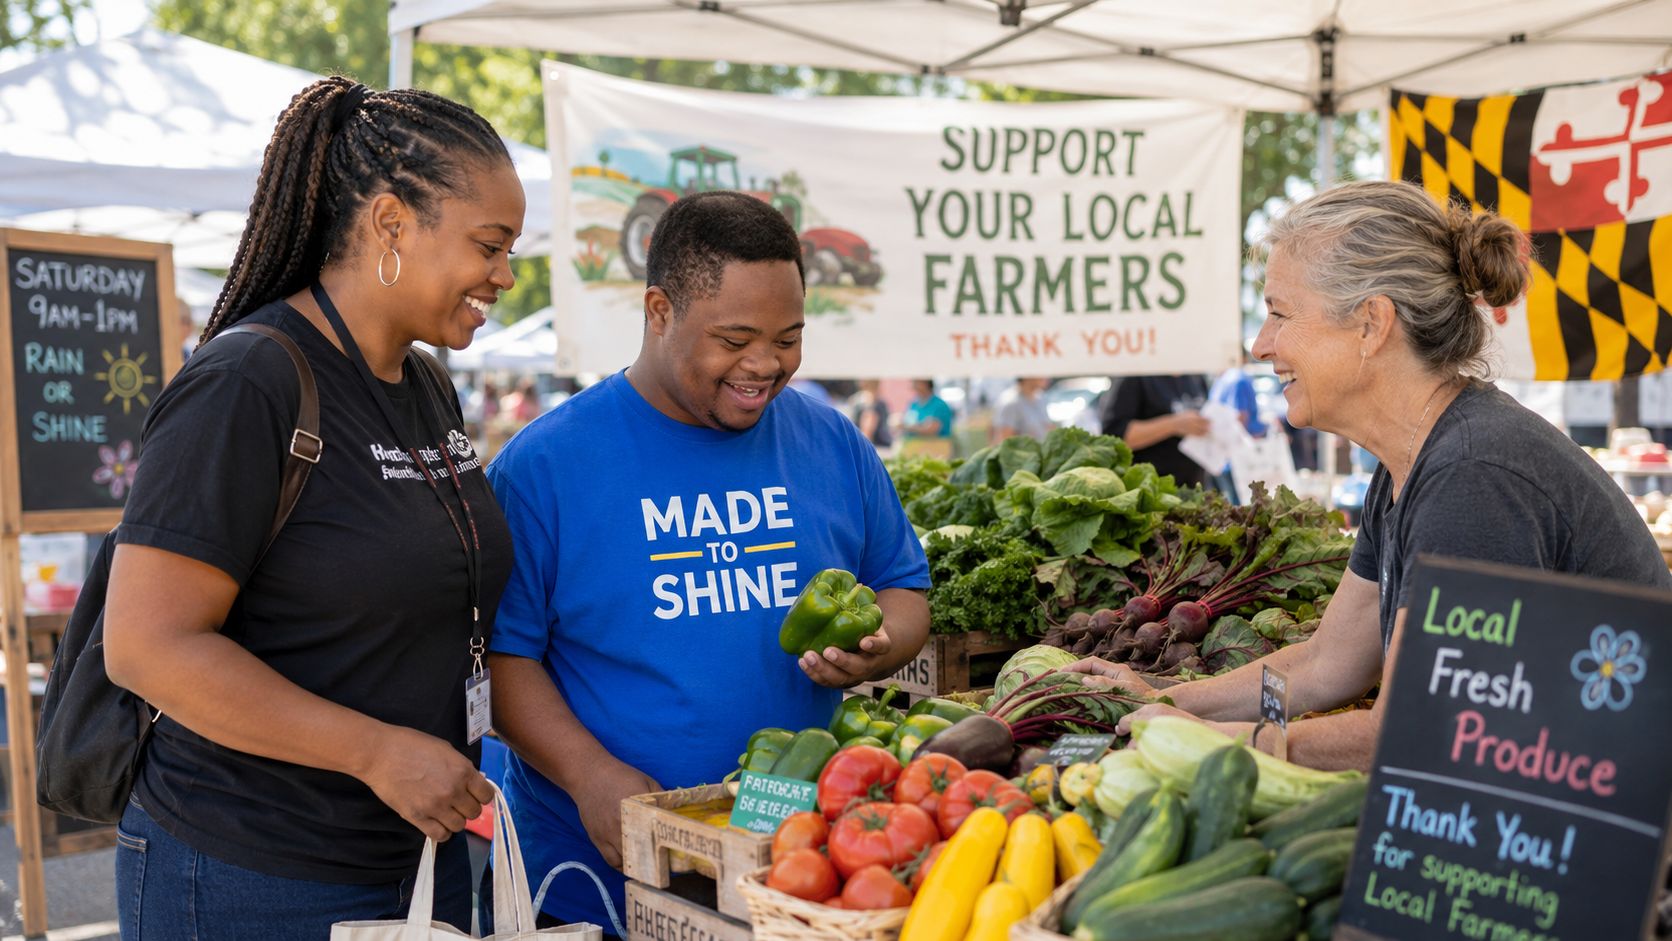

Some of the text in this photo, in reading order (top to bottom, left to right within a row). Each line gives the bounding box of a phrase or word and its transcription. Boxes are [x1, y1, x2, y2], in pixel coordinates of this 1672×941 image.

[940, 127, 1145, 176] SUPPORT
[904, 187, 1204, 241] YOUR LOCAL
[15, 257, 145, 302] SATURDAY
[923, 251, 1187, 316] FARMERS
[28, 294, 138, 334] 9AM-1PM
[25, 342, 84, 375] RAIN
[950, 327, 1158, 359] THANK YOU!
[43, 381, 75, 405] OR
[32, 412, 107, 443] SHINE
[640, 486, 794, 541] MADE
[706, 541, 738, 563] TO
[652, 562, 799, 620] SHINE
[1422, 586, 1522, 647] Local
[1428, 648, 1533, 714] Fresh
[1451, 709, 1618, 797] Produce
[1382, 785, 1576, 876] Thank You!
[1364, 872, 1561, 941] Local Farme
[1372, 833, 1560, 930] for supporting
